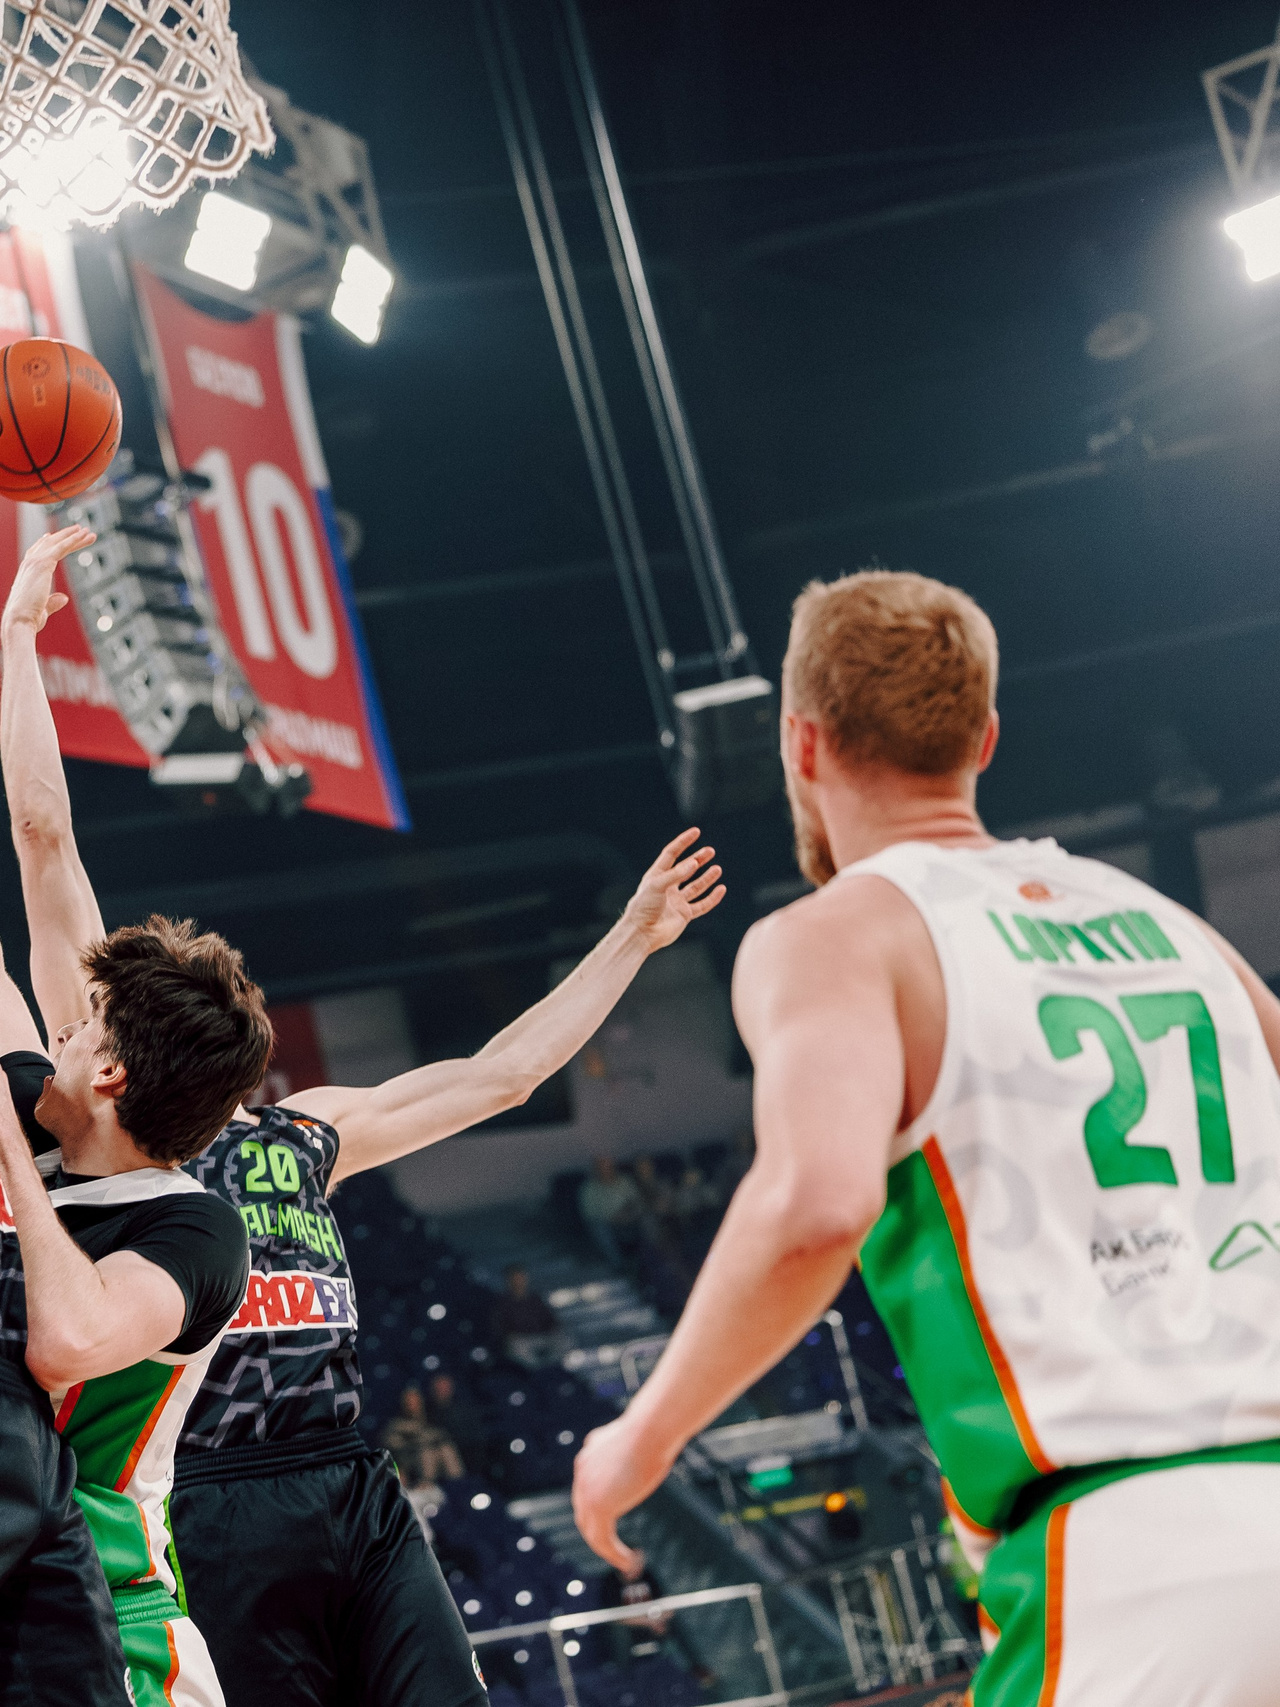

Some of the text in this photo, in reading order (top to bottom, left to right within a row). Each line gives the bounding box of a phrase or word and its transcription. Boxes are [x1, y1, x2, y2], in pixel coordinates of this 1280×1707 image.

[194, 448, 339, 673] 10
[240, 1139, 301, 1193] 20
[1037, 990, 1236, 1188] 27
